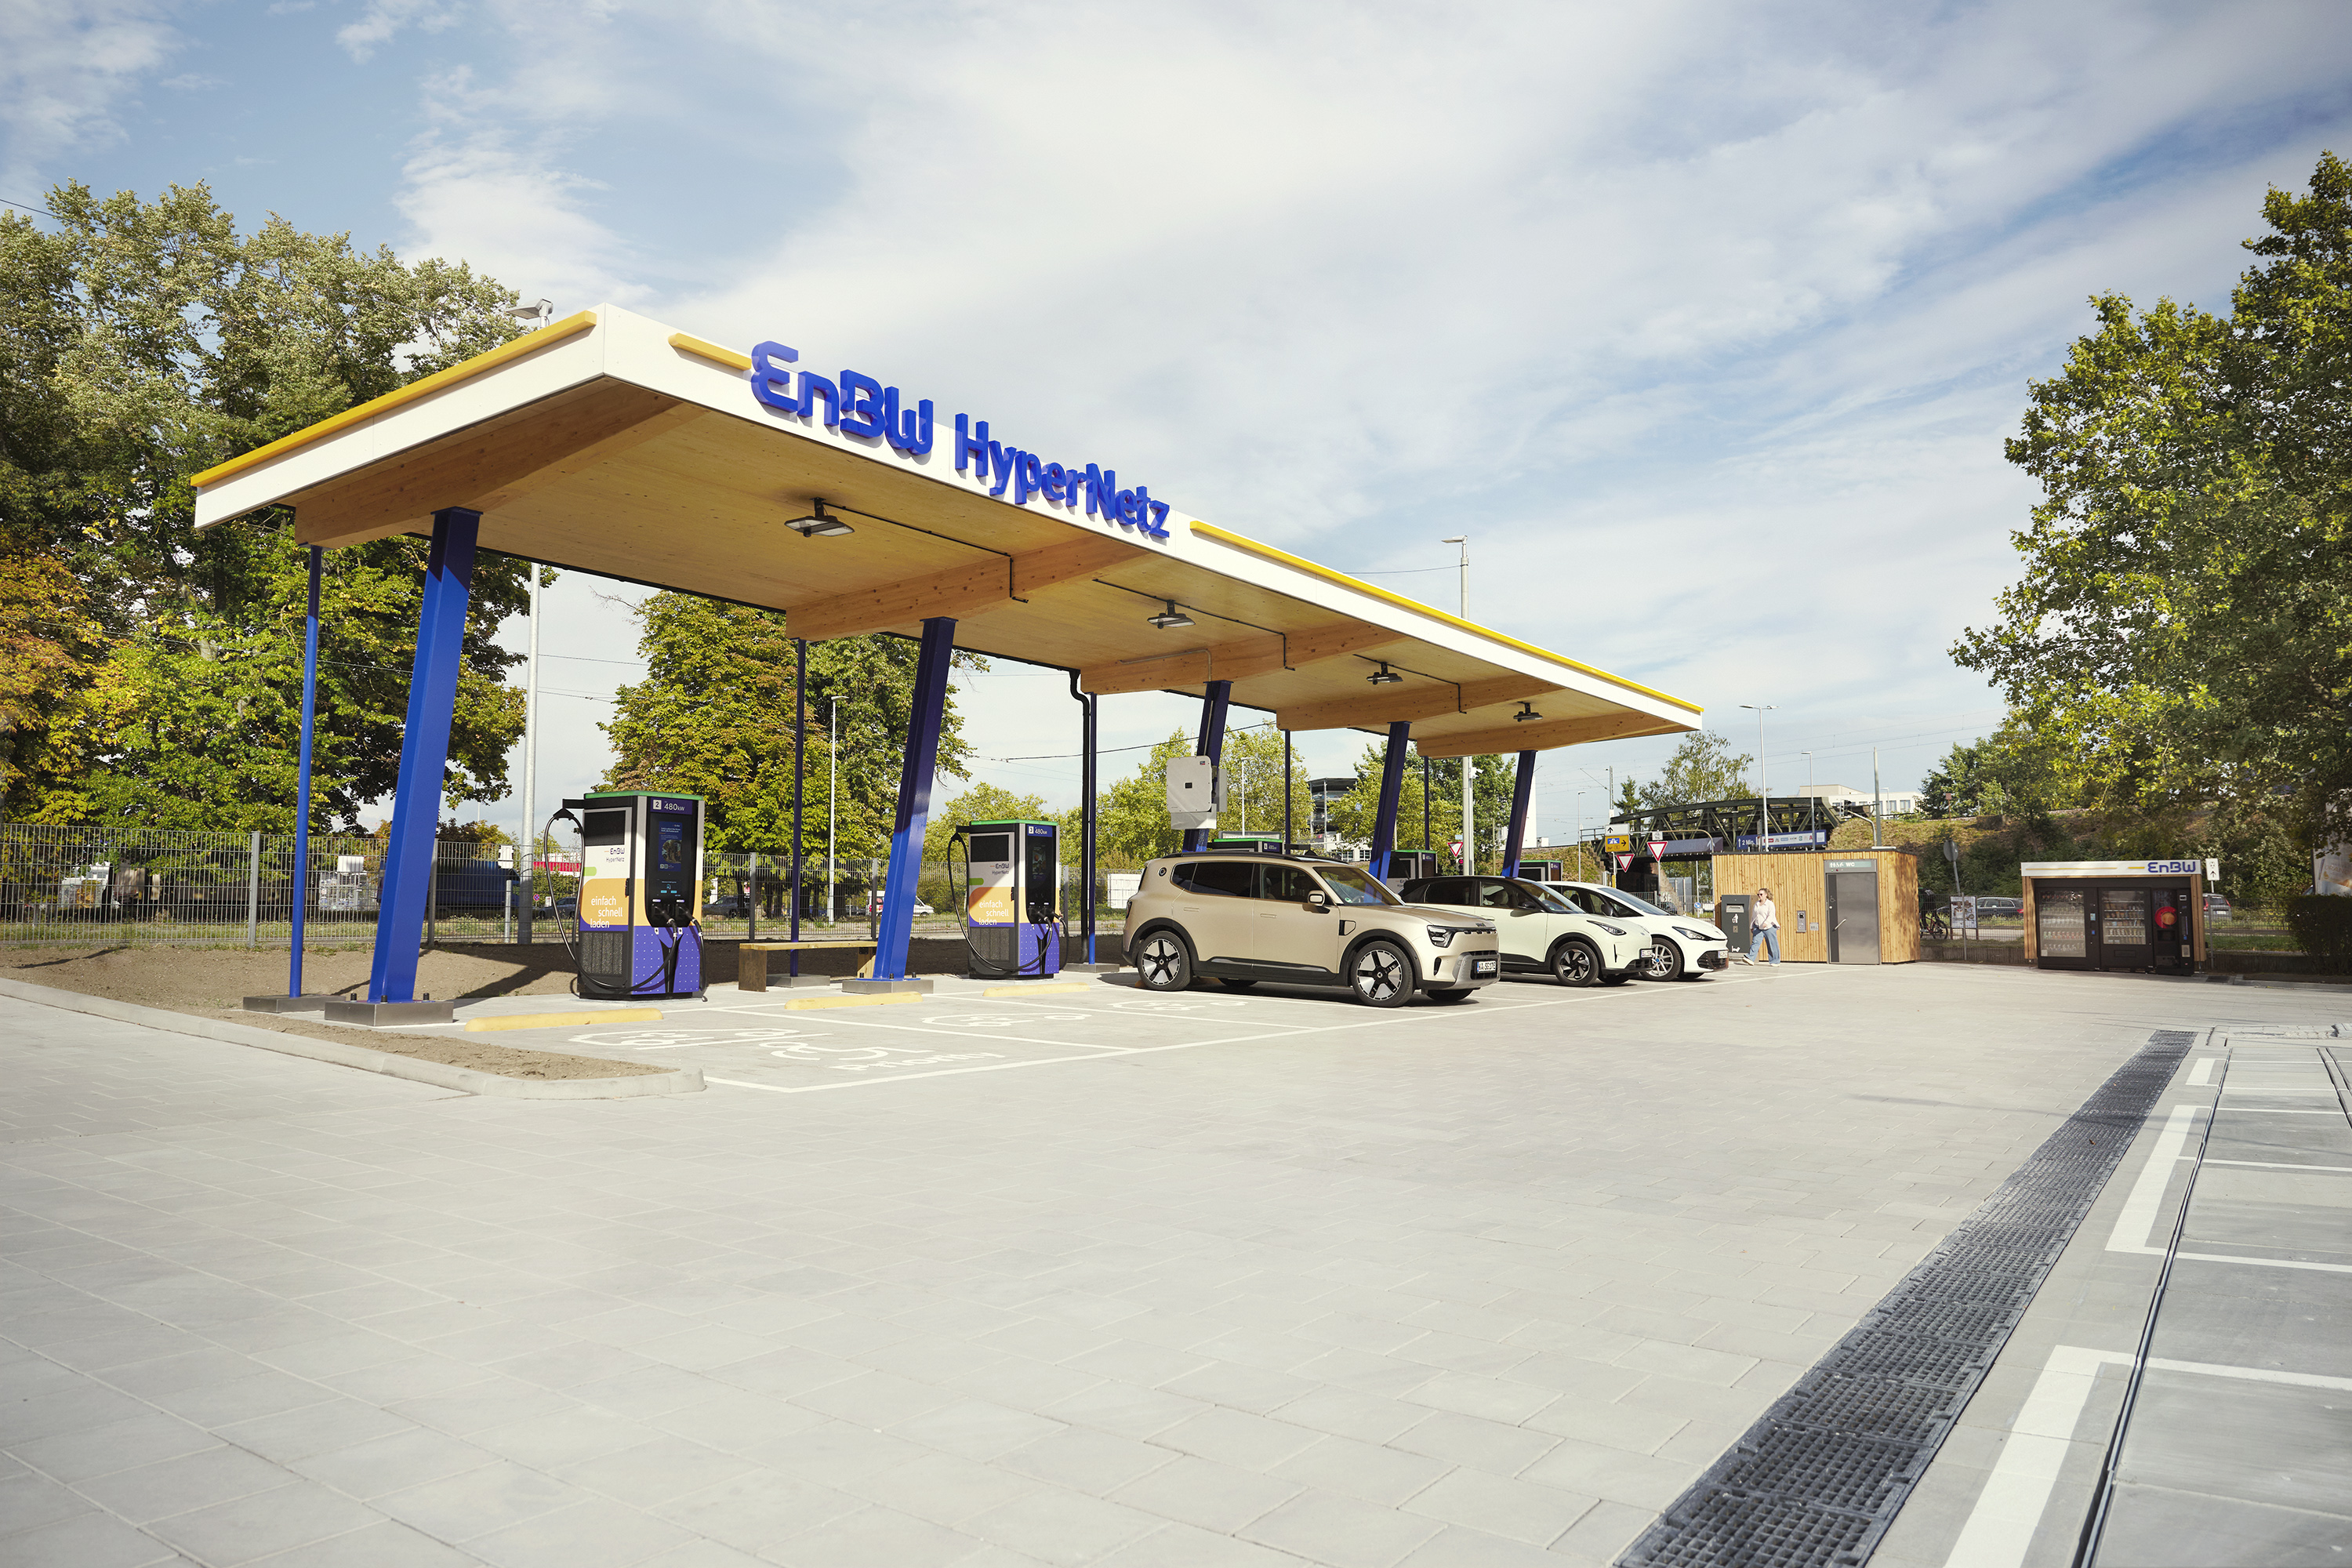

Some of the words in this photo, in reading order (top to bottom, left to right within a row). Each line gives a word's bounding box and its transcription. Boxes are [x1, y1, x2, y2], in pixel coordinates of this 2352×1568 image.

[751, 340, 933, 455] EnBW
[955, 412, 1170, 539] HyperNetz
[2147, 862, 2196, 873] EnBW
[591, 896, 616, 906] einfach
[598, 907, 622, 916] schnell
[590, 918, 609, 928] laden
